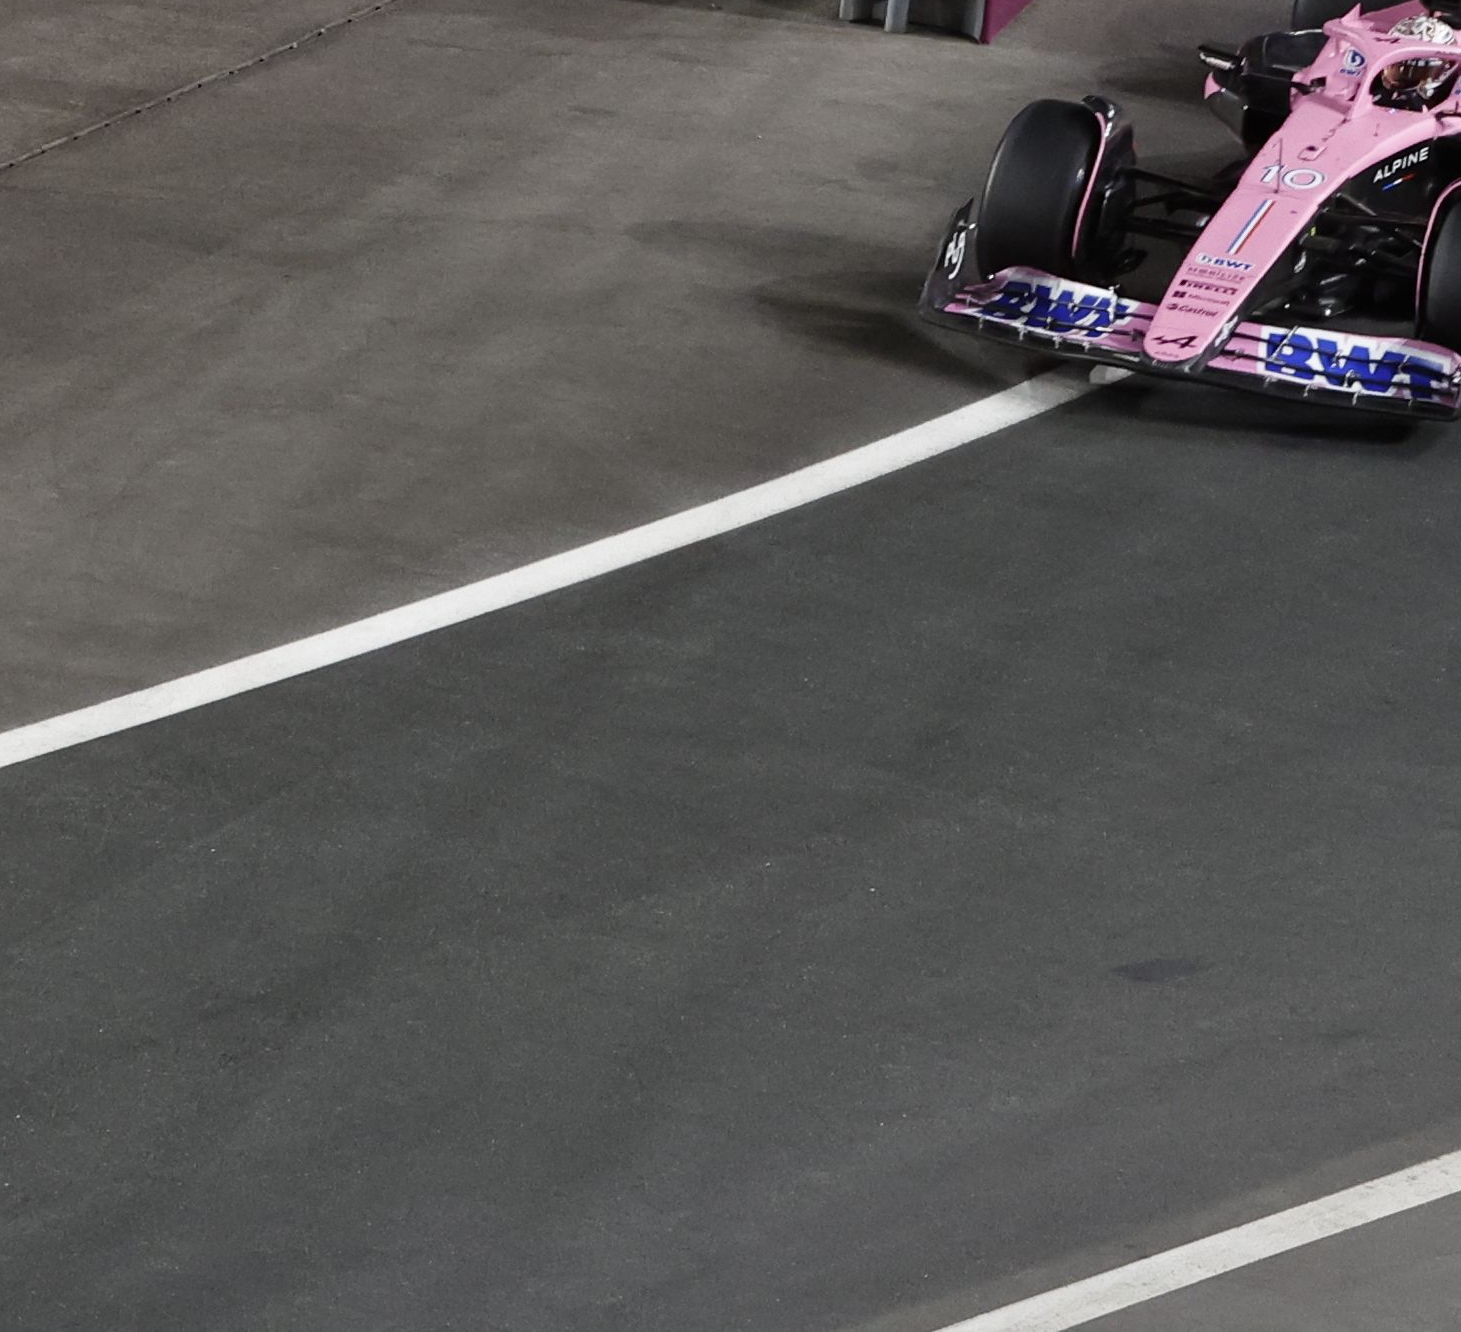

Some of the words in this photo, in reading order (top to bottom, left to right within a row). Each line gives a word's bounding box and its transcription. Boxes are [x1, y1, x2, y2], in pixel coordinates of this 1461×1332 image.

[1260, 164, 1325, 189] 10
[1373, 146, 1430, 184] ALPINE
[1214, 259, 1252, 271] BWT
[981, 280, 1133, 338] BWT
[1266, 332, 1445, 400] BWT
